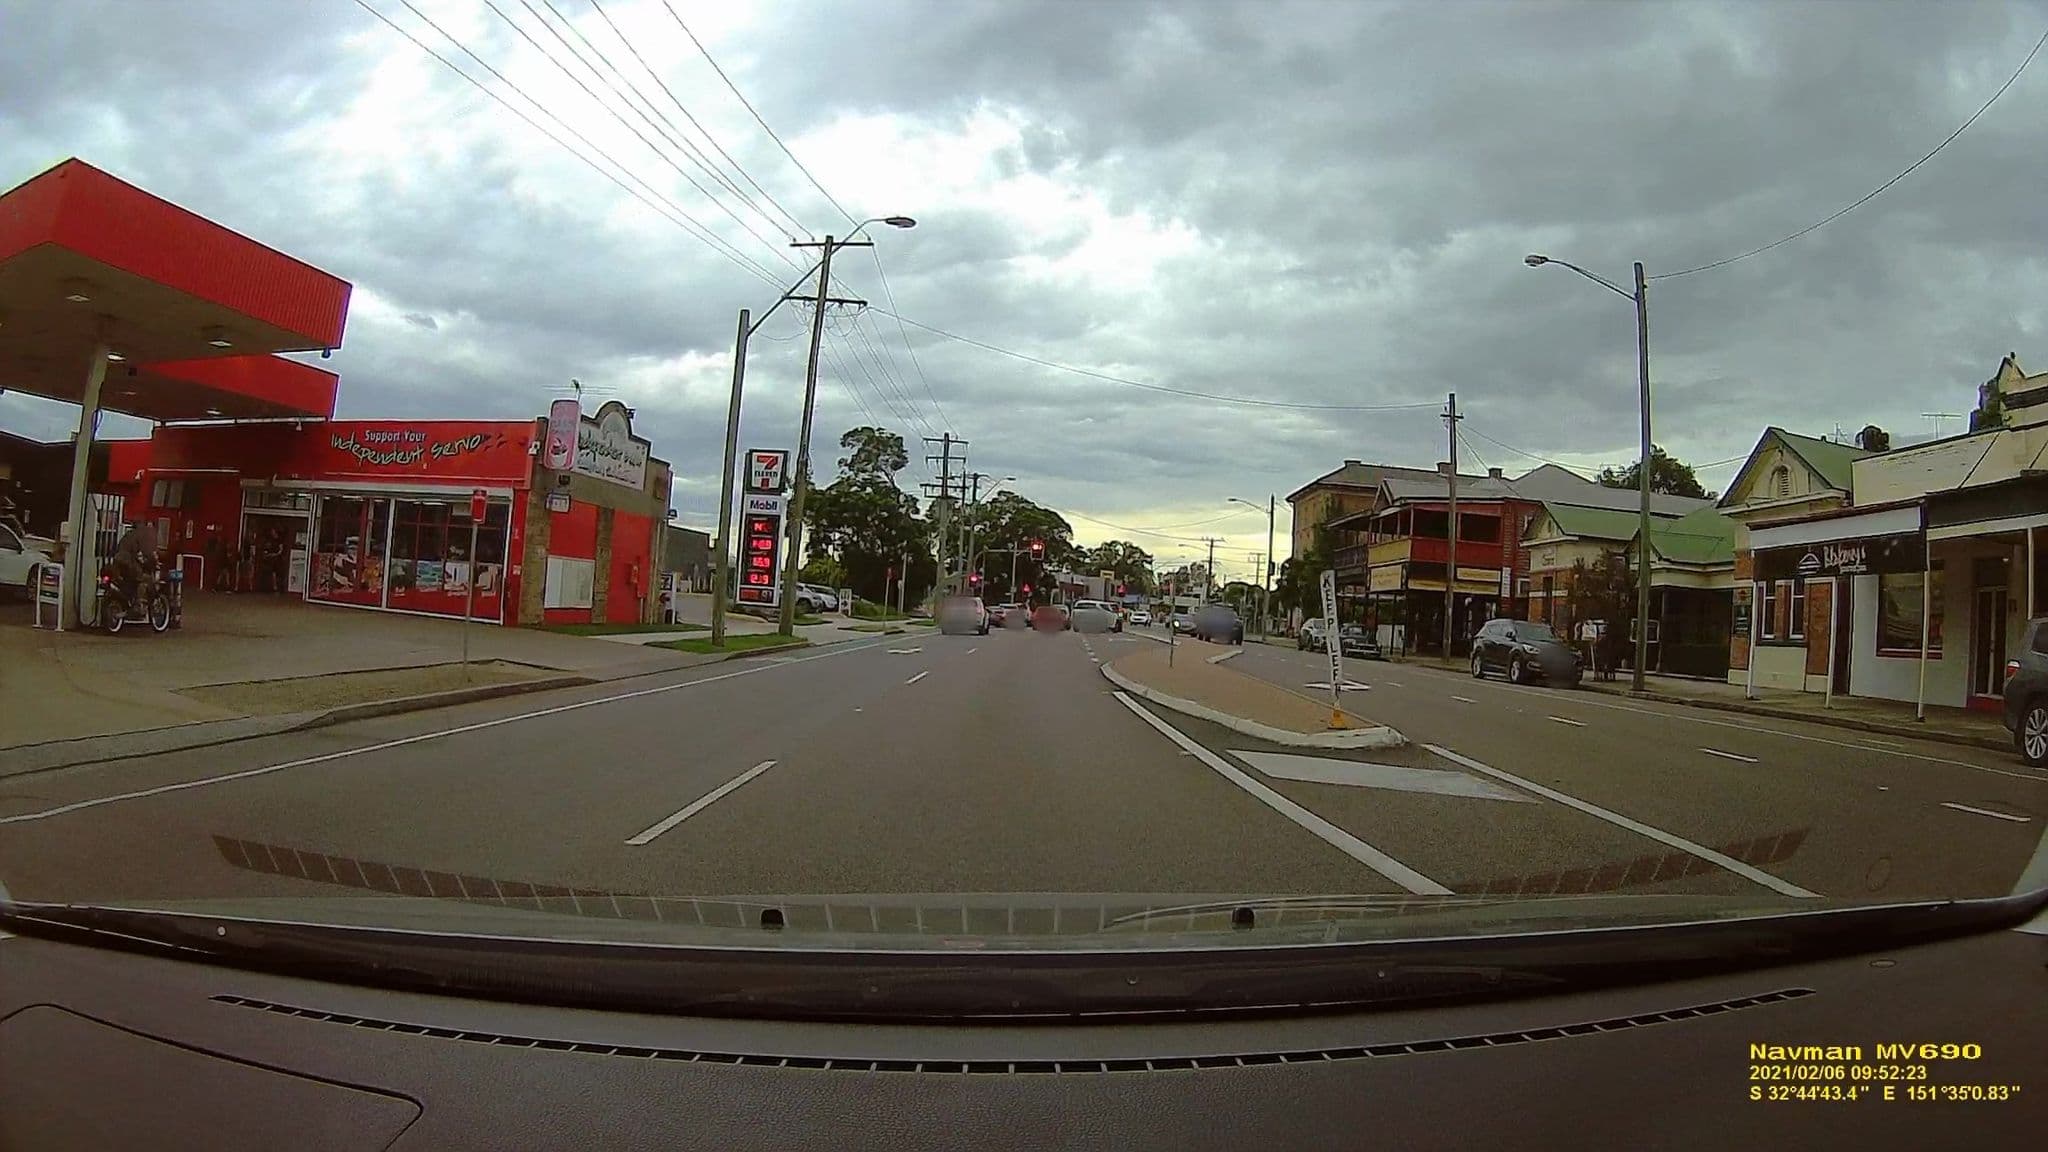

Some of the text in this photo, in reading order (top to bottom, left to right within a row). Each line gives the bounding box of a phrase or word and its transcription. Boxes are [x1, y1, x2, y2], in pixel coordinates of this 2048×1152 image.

[364, 429, 426, 443] Support Your
[331, 432, 424, 466] Independent
[750, 500, 778, 510] Mobil
[1322, 575, 1335, 631] KEEP
